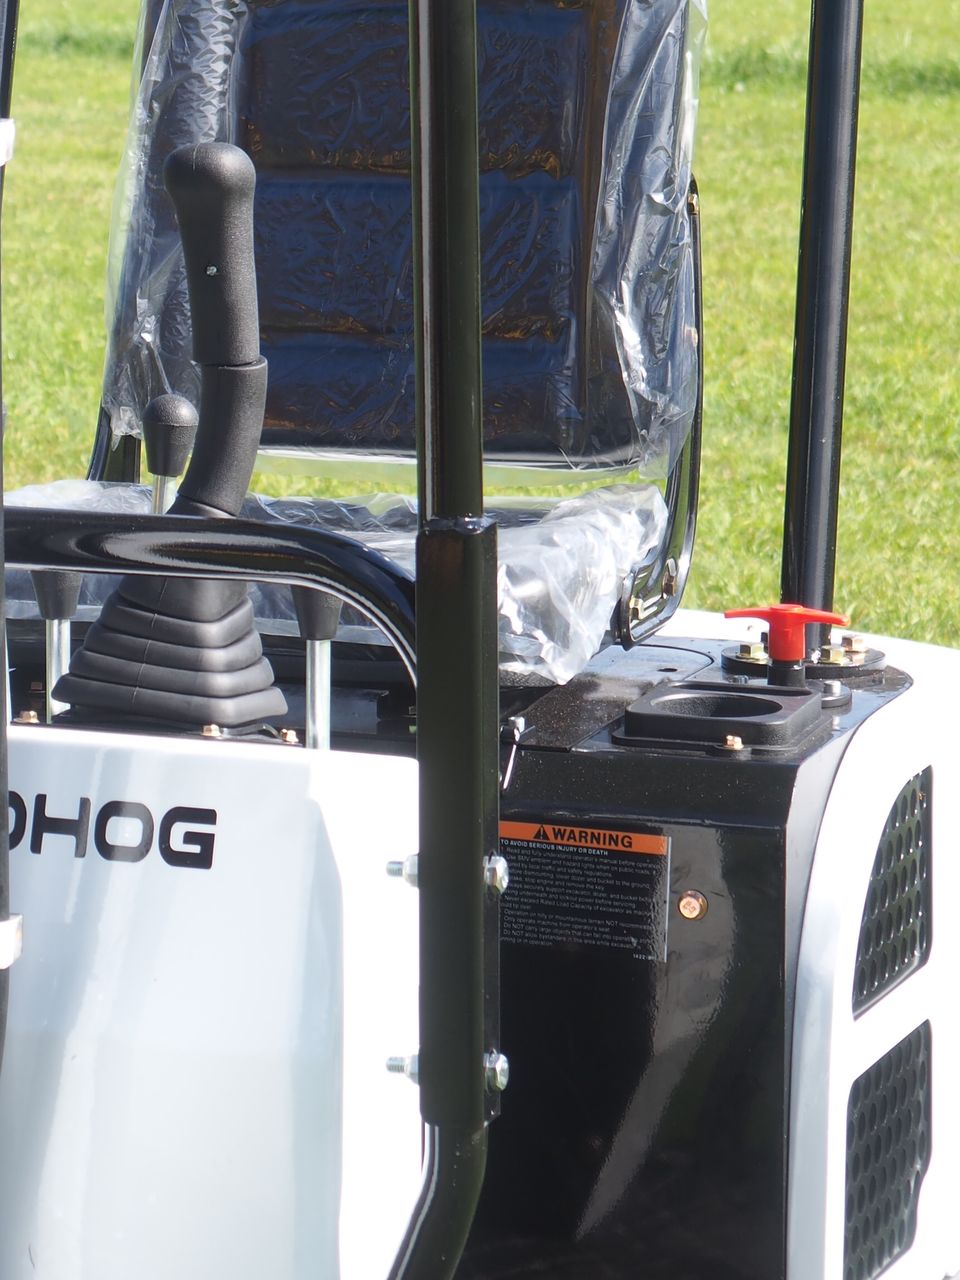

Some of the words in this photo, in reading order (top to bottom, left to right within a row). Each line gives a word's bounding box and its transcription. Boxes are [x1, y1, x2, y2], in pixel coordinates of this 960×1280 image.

[552, 827, 632, 848] WARNING
[510, 839, 528, 847] AVOID
[529, 841, 555, 850] SERIOUS
[556, 844, 577, 853] INJURY
[578, 846, 587, 854] OR
[588, 847, 608, 856] DEATH
